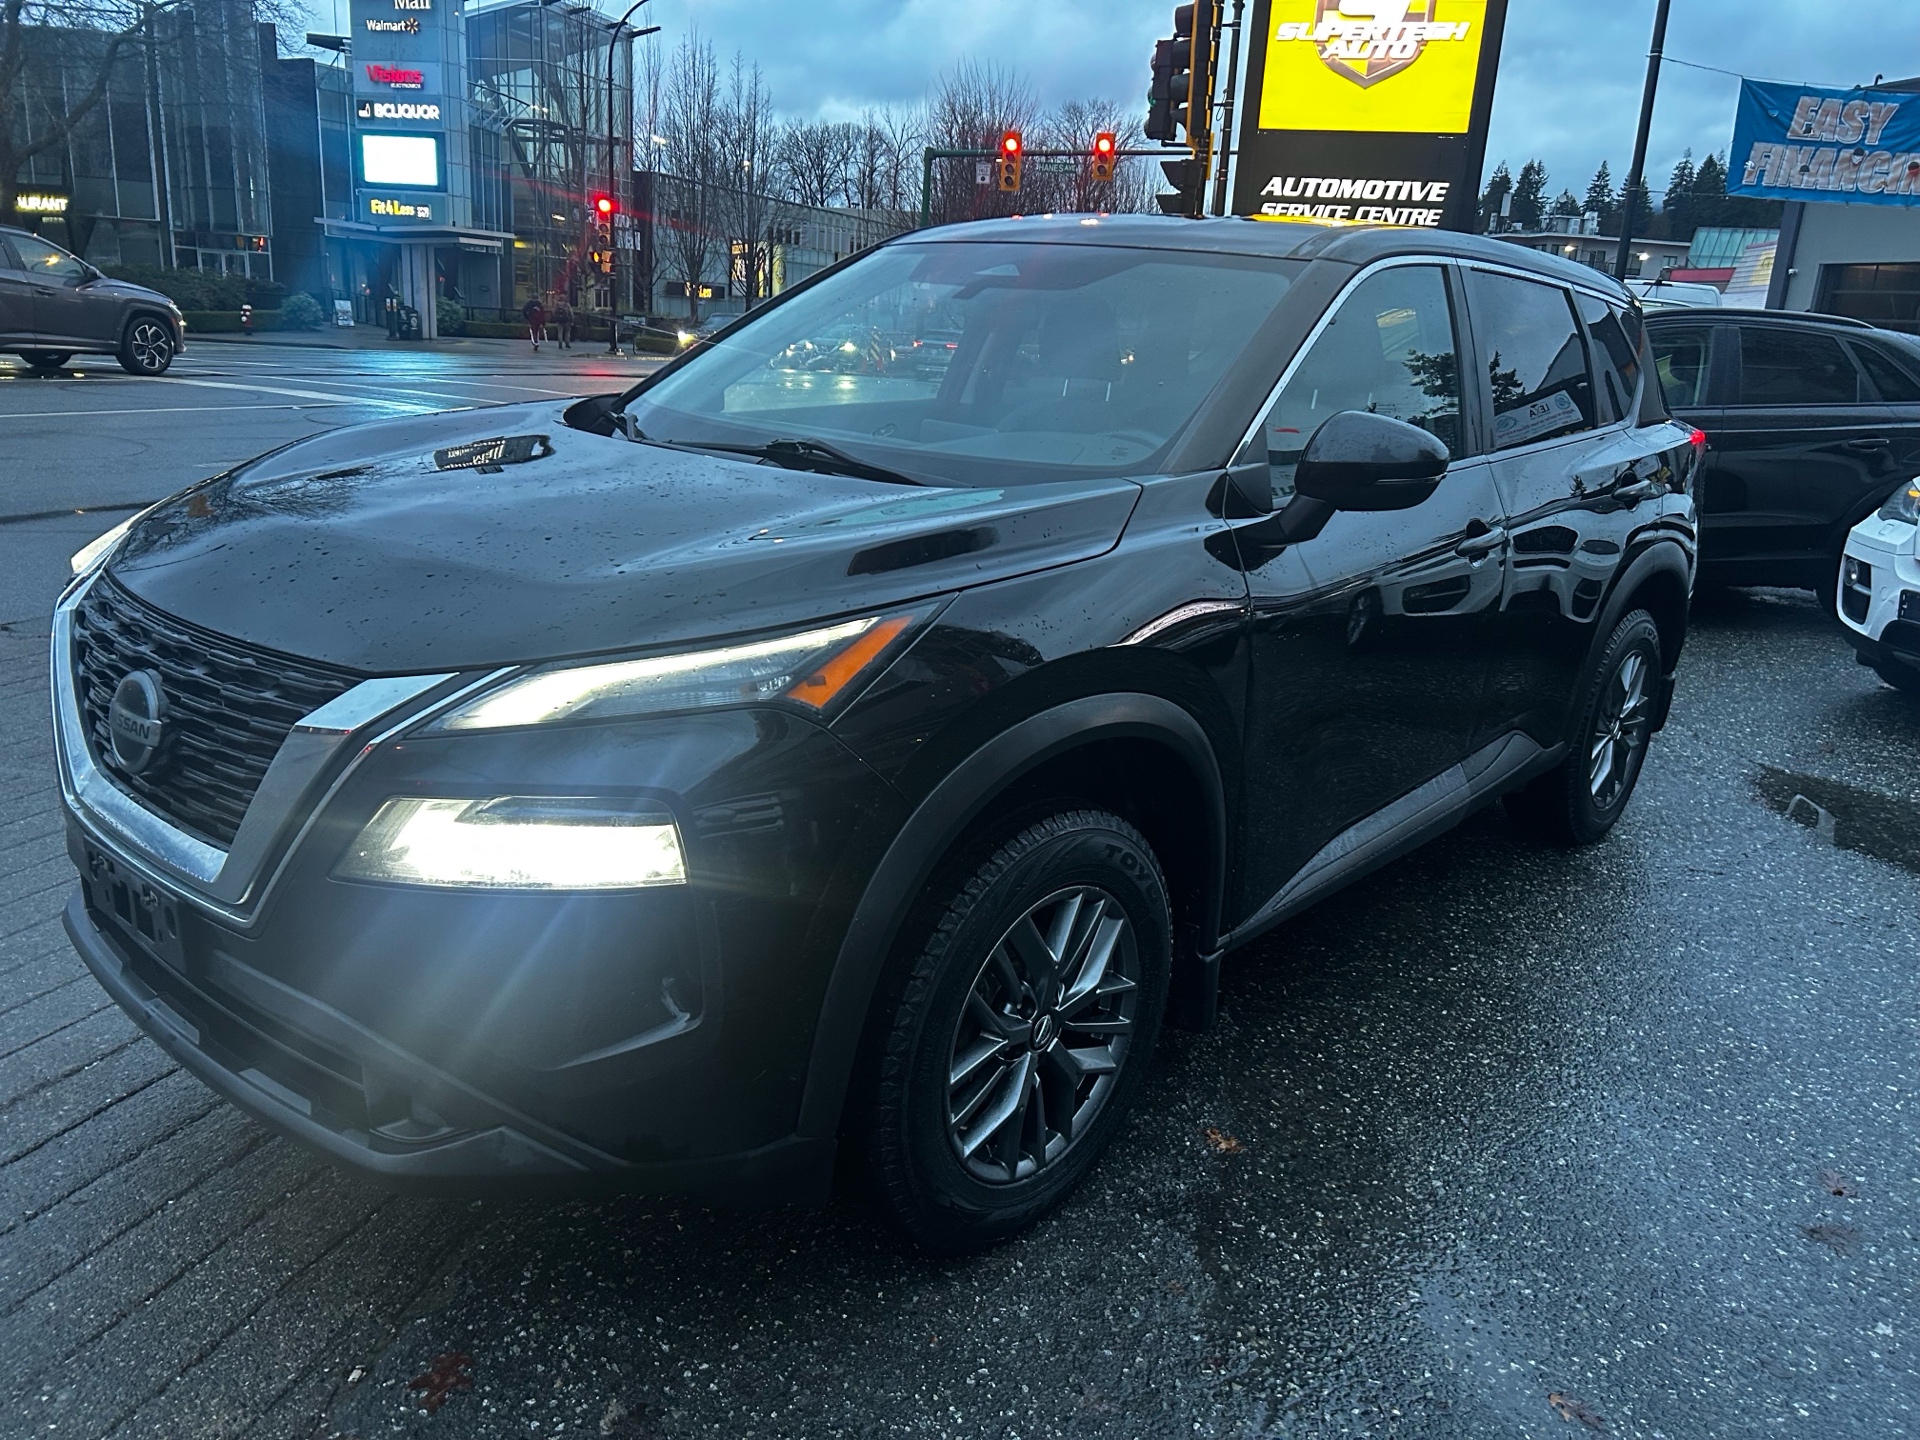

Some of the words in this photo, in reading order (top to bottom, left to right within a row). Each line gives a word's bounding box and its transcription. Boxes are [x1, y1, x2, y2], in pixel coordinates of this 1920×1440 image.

[366, 19, 406, 31] Walmart
[1275, 21, 1471, 41] SUPERTECH
[1320, 40, 1419, 59] AUTO
[365, 64, 423, 83] Visions
[1786, 95, 1899, 146] EASY
[1260, 176, 1450, 202] AUTOMOTIVE
[1260, 202, 1352, 220] SERVICE
[1354, 205, 1443, 227] CENTRE
[114, 710, 151, 740] SSAN
